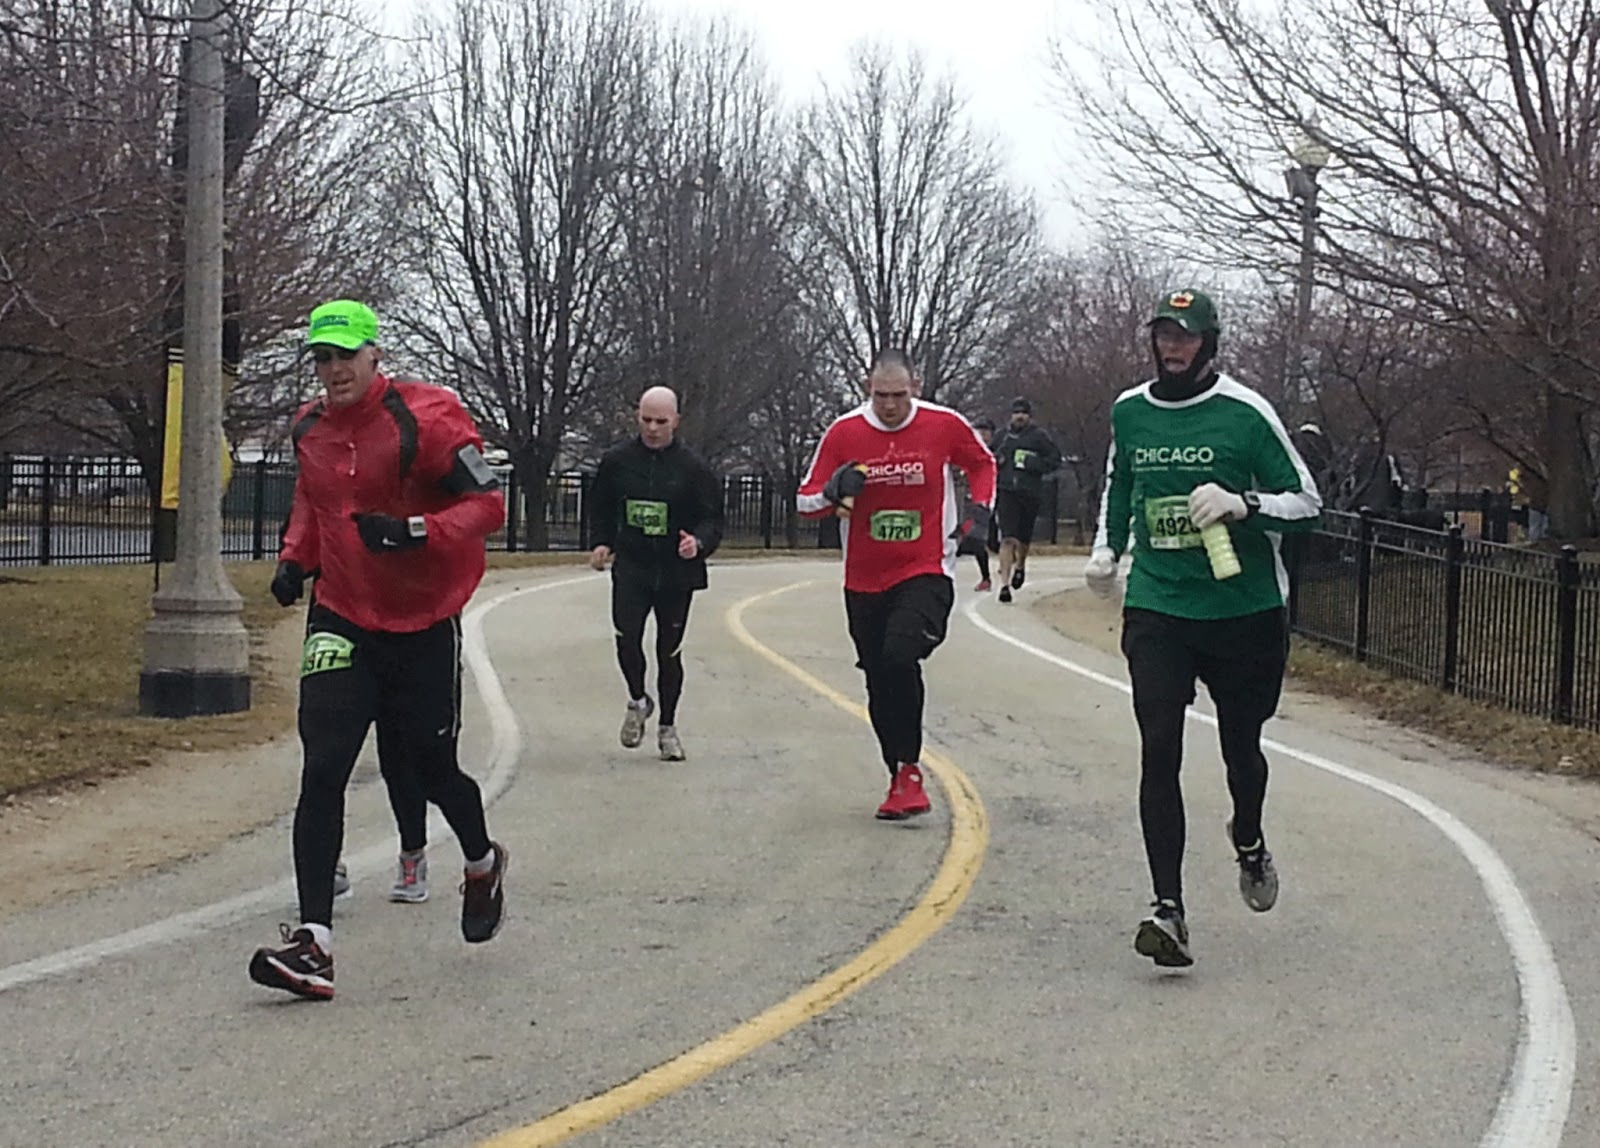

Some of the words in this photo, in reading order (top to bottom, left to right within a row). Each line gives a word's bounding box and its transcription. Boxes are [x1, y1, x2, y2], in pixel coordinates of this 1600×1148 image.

[1135, 446, 1214, 464] CHICAGO
[867, 461, 924, 477] CHICAGO
[878, 524, 912, 539] 4720
